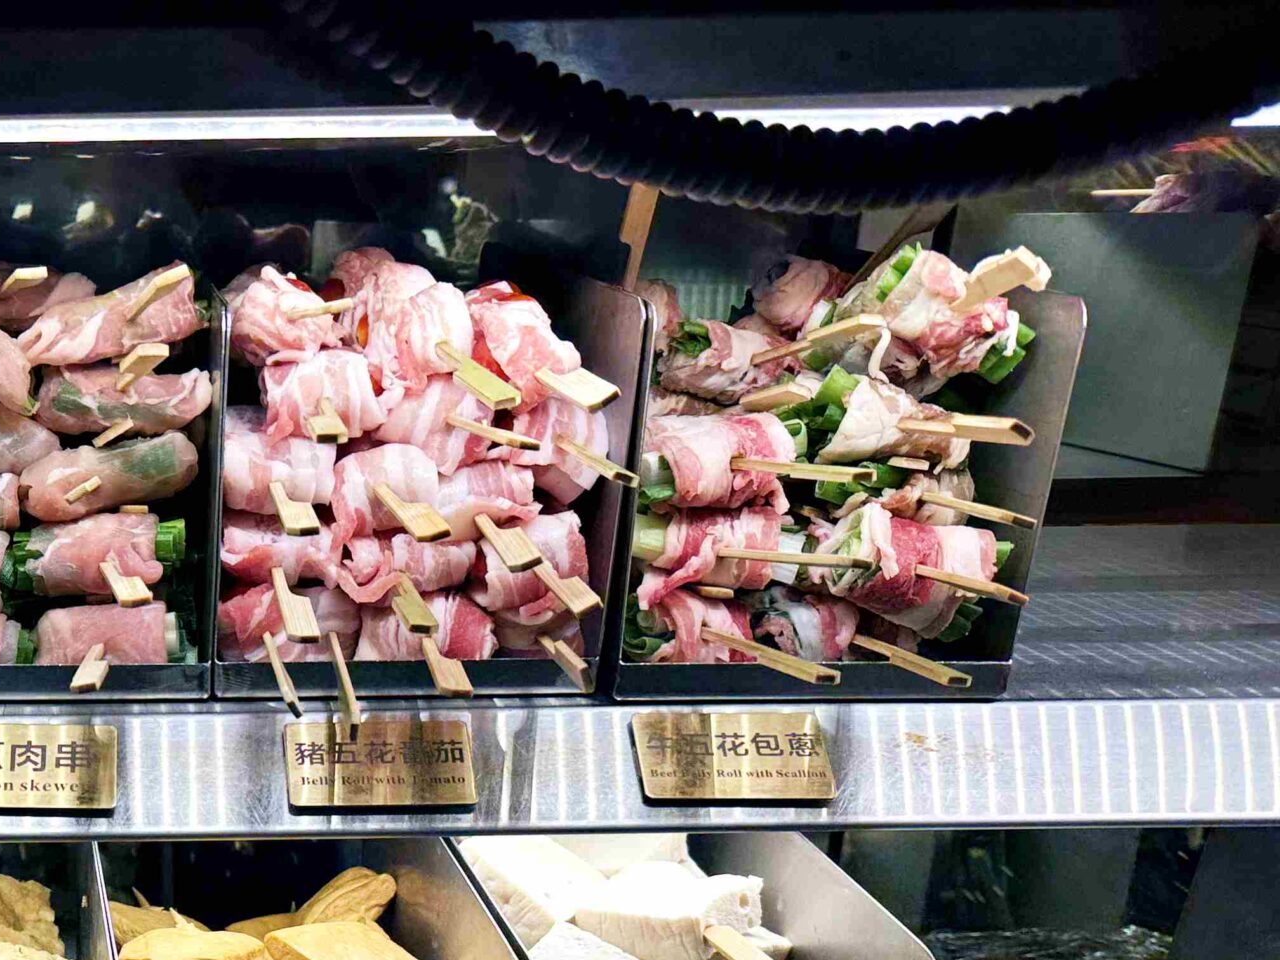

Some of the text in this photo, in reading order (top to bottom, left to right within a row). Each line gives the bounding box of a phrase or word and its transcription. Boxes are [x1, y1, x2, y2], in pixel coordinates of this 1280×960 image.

[716, 769, 742, 778] Roll
[746, 769, 773, 778] with
[373, 776, 405, 786] with
